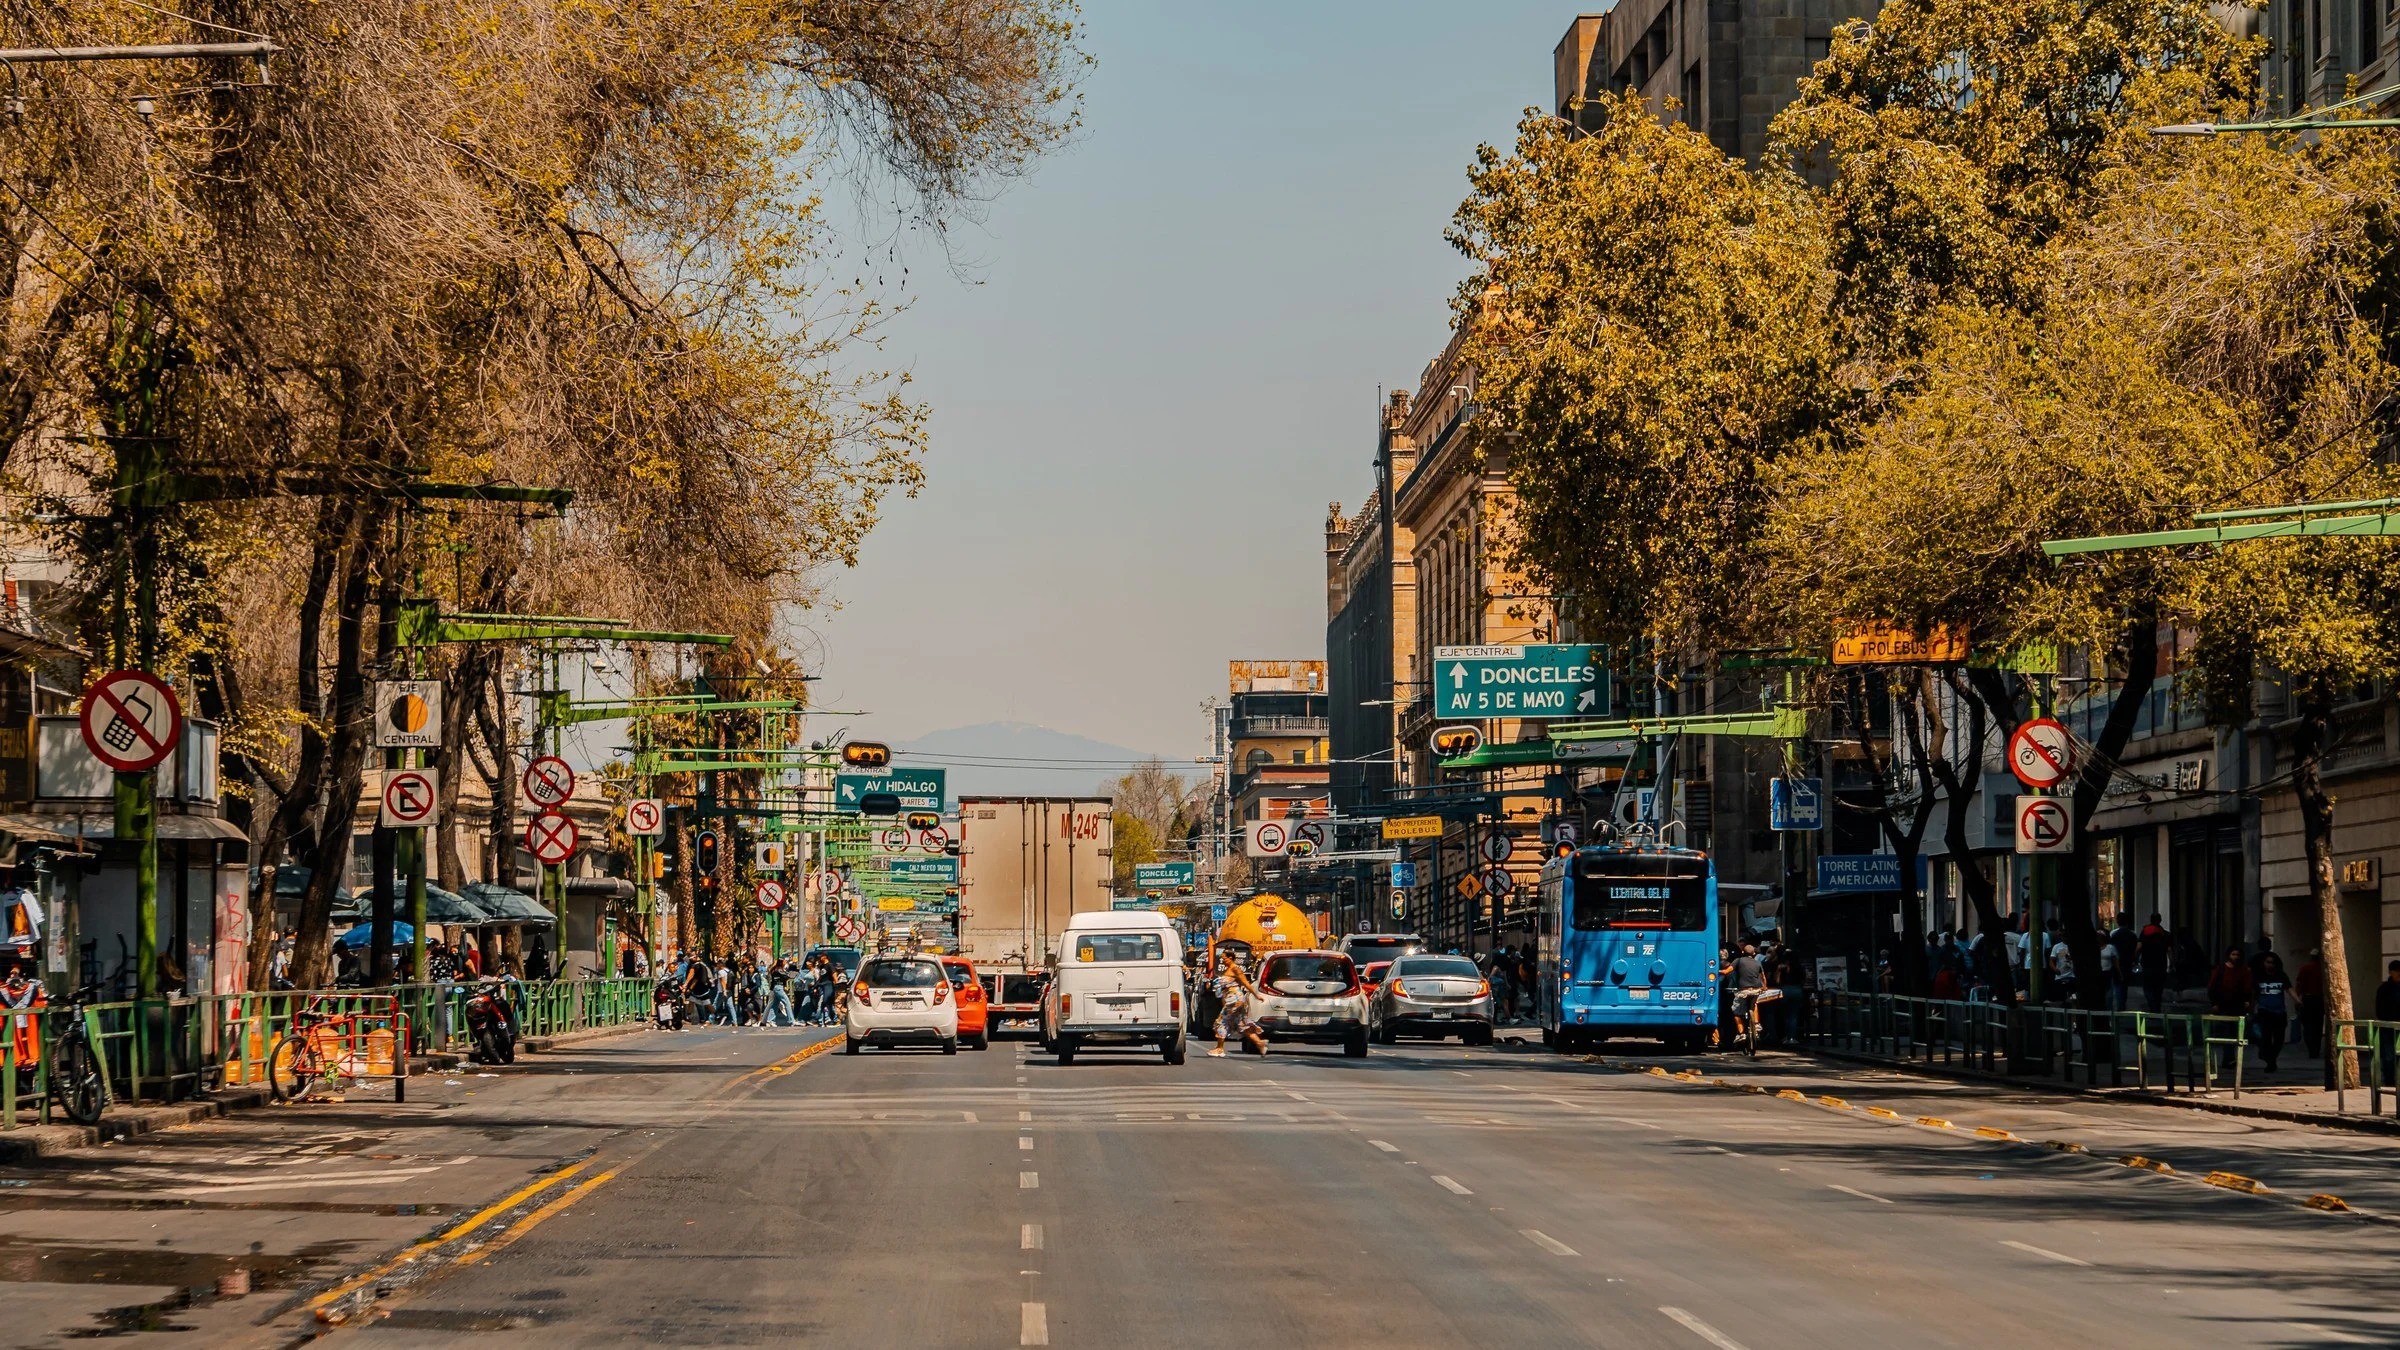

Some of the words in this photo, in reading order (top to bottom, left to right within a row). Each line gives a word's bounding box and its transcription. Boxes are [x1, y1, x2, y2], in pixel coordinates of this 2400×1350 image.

[1440, 648, 1461, 657] EJE
[1466, 647, 1517, 656] CENTRAL
[1838, 643, 1854, 656] AL
[1861, 641, 1928, 656] TROLEBUS
[1481, 666, 1595, 685] DONCELES
[400, 684, 418, 692] EJE
[1451, 693, 1472, 709] AV
[1478, 692, 1489, 709] 5
[1496, 692, 1516, 709] DE
[1523, 690, 1565, 708] MAYO
[384, 735, 434, 744] CENTRAL
[864, 781, 881, 791] AV
[886, 781, 937, 793] HIDALGO
[1061, 813, 1099, 840] M-248
[1389, 827, 1437, 835] TROLEBUS
[1824, 861, 1859, 872] TORRE
[1140, 870, 1179, 878] DONCELES
[1829, 874, 1896, 885] AMERICANA
[1663, 991, 1699, 1000] 22024
